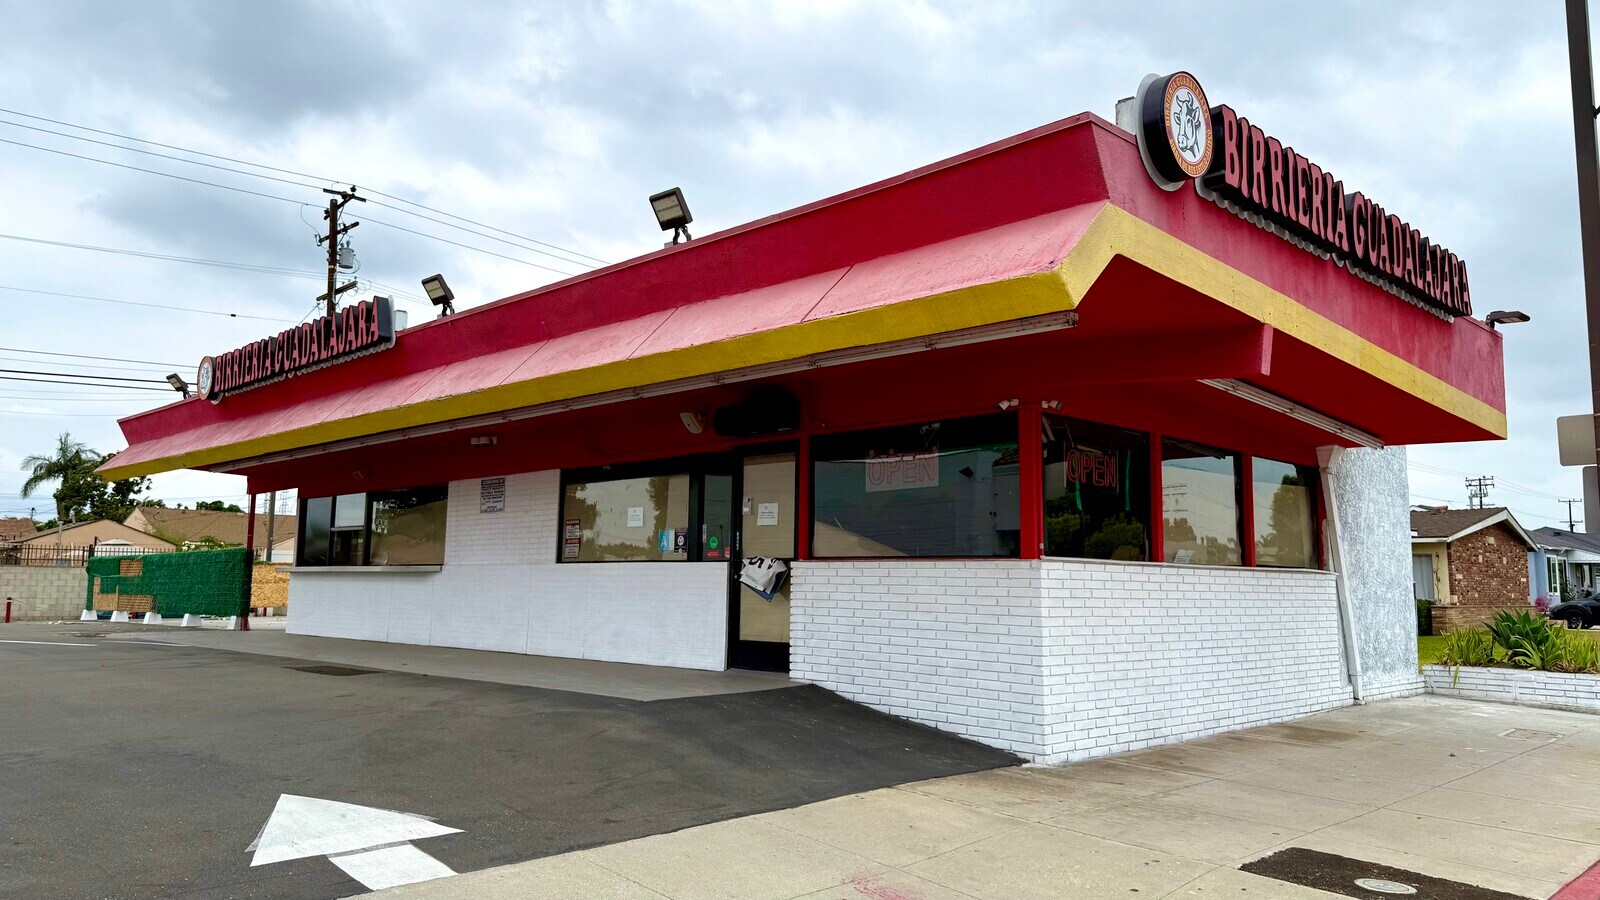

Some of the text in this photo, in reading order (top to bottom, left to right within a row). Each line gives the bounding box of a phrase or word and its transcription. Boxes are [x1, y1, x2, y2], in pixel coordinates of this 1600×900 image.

[1222, 104, 1473, 316] BIRRIERIA GUADALAJARA
[214, 336, 271, 393] BIRRIERIA
[274, 296, 379, 373] GUADALAJARA
[868, 452, 935, 486] OPEN
[1066, 449, 1117, 488] OPEN
